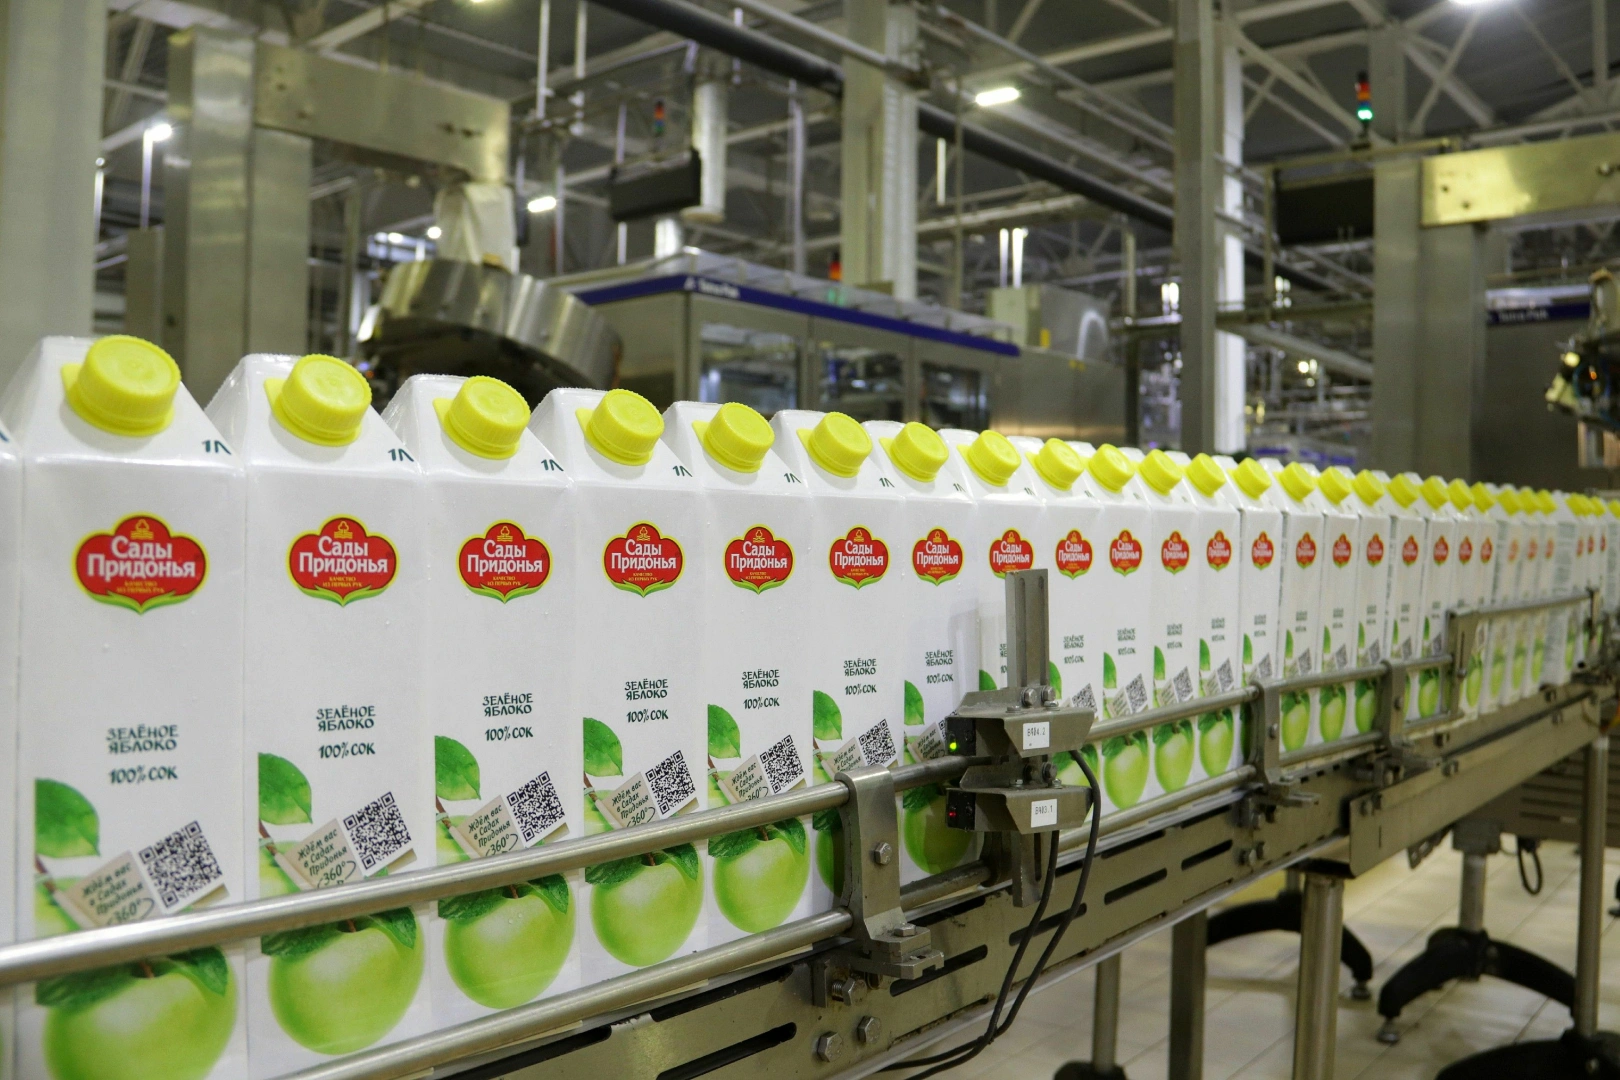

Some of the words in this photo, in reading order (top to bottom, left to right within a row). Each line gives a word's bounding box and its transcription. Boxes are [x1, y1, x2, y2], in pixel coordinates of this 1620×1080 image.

[111, 535, 173, 560] Сады
[318, 535, 369, 557] Сады
[483, 539, 526, 559] Сады
[625, 538, 662, 557] Сады
[742, 541, 775, 558] Сады
[845, 540, 873, 555] Сады
[925, 541, 950, 555] Сады
[1000, 541, 1022, 554] Сады
[299, 552, 388, 577] Придонья
[611, 552, 677, 574] Придонья
[730, 553, 788, 573] Придонья
[834, 551, 884, 569] Придонья
[917, 551, 959, 568] Придонья
[993, 550, 1030, 565] Придонья
[87, 553, 196, 582] Придонья
[467, 554, 543, 577] Придонья
[925, 649, 954, 659] ЗЕЛЁНОЕ
[843, 658, 877, 669] ЗЕЛЁНОЕ
[926, 658, 953, 667] ЯБЛОКО
[741, 668, 780, 680] ЗЕЛЁНОЕ
[844, 667, 876, 677] ЯБЛОКО
[624, 678, 669, 691] ЗЕЛЁНОЕ
[743, 679, 779, 689] ЯБЛОКО
[482, 692, 534, 706] ЗЕЛЁНОЕ
[626, 689, 668, 701] ЯБЛОКО
[316, 705, 376, 720] ЗЕЛЁНОЕ
[484, 704, 533, 717] ЯБЛОКО
[106, 723, 179, 741] ЗЕЛЁНОЕ
[318, 718, 375, 732] ЯБЛОКО
[108, 738, 177, 754] ЯБЛОКО
[491, 804, 502, 817] вас
[324, 829, 337, 842] вас
